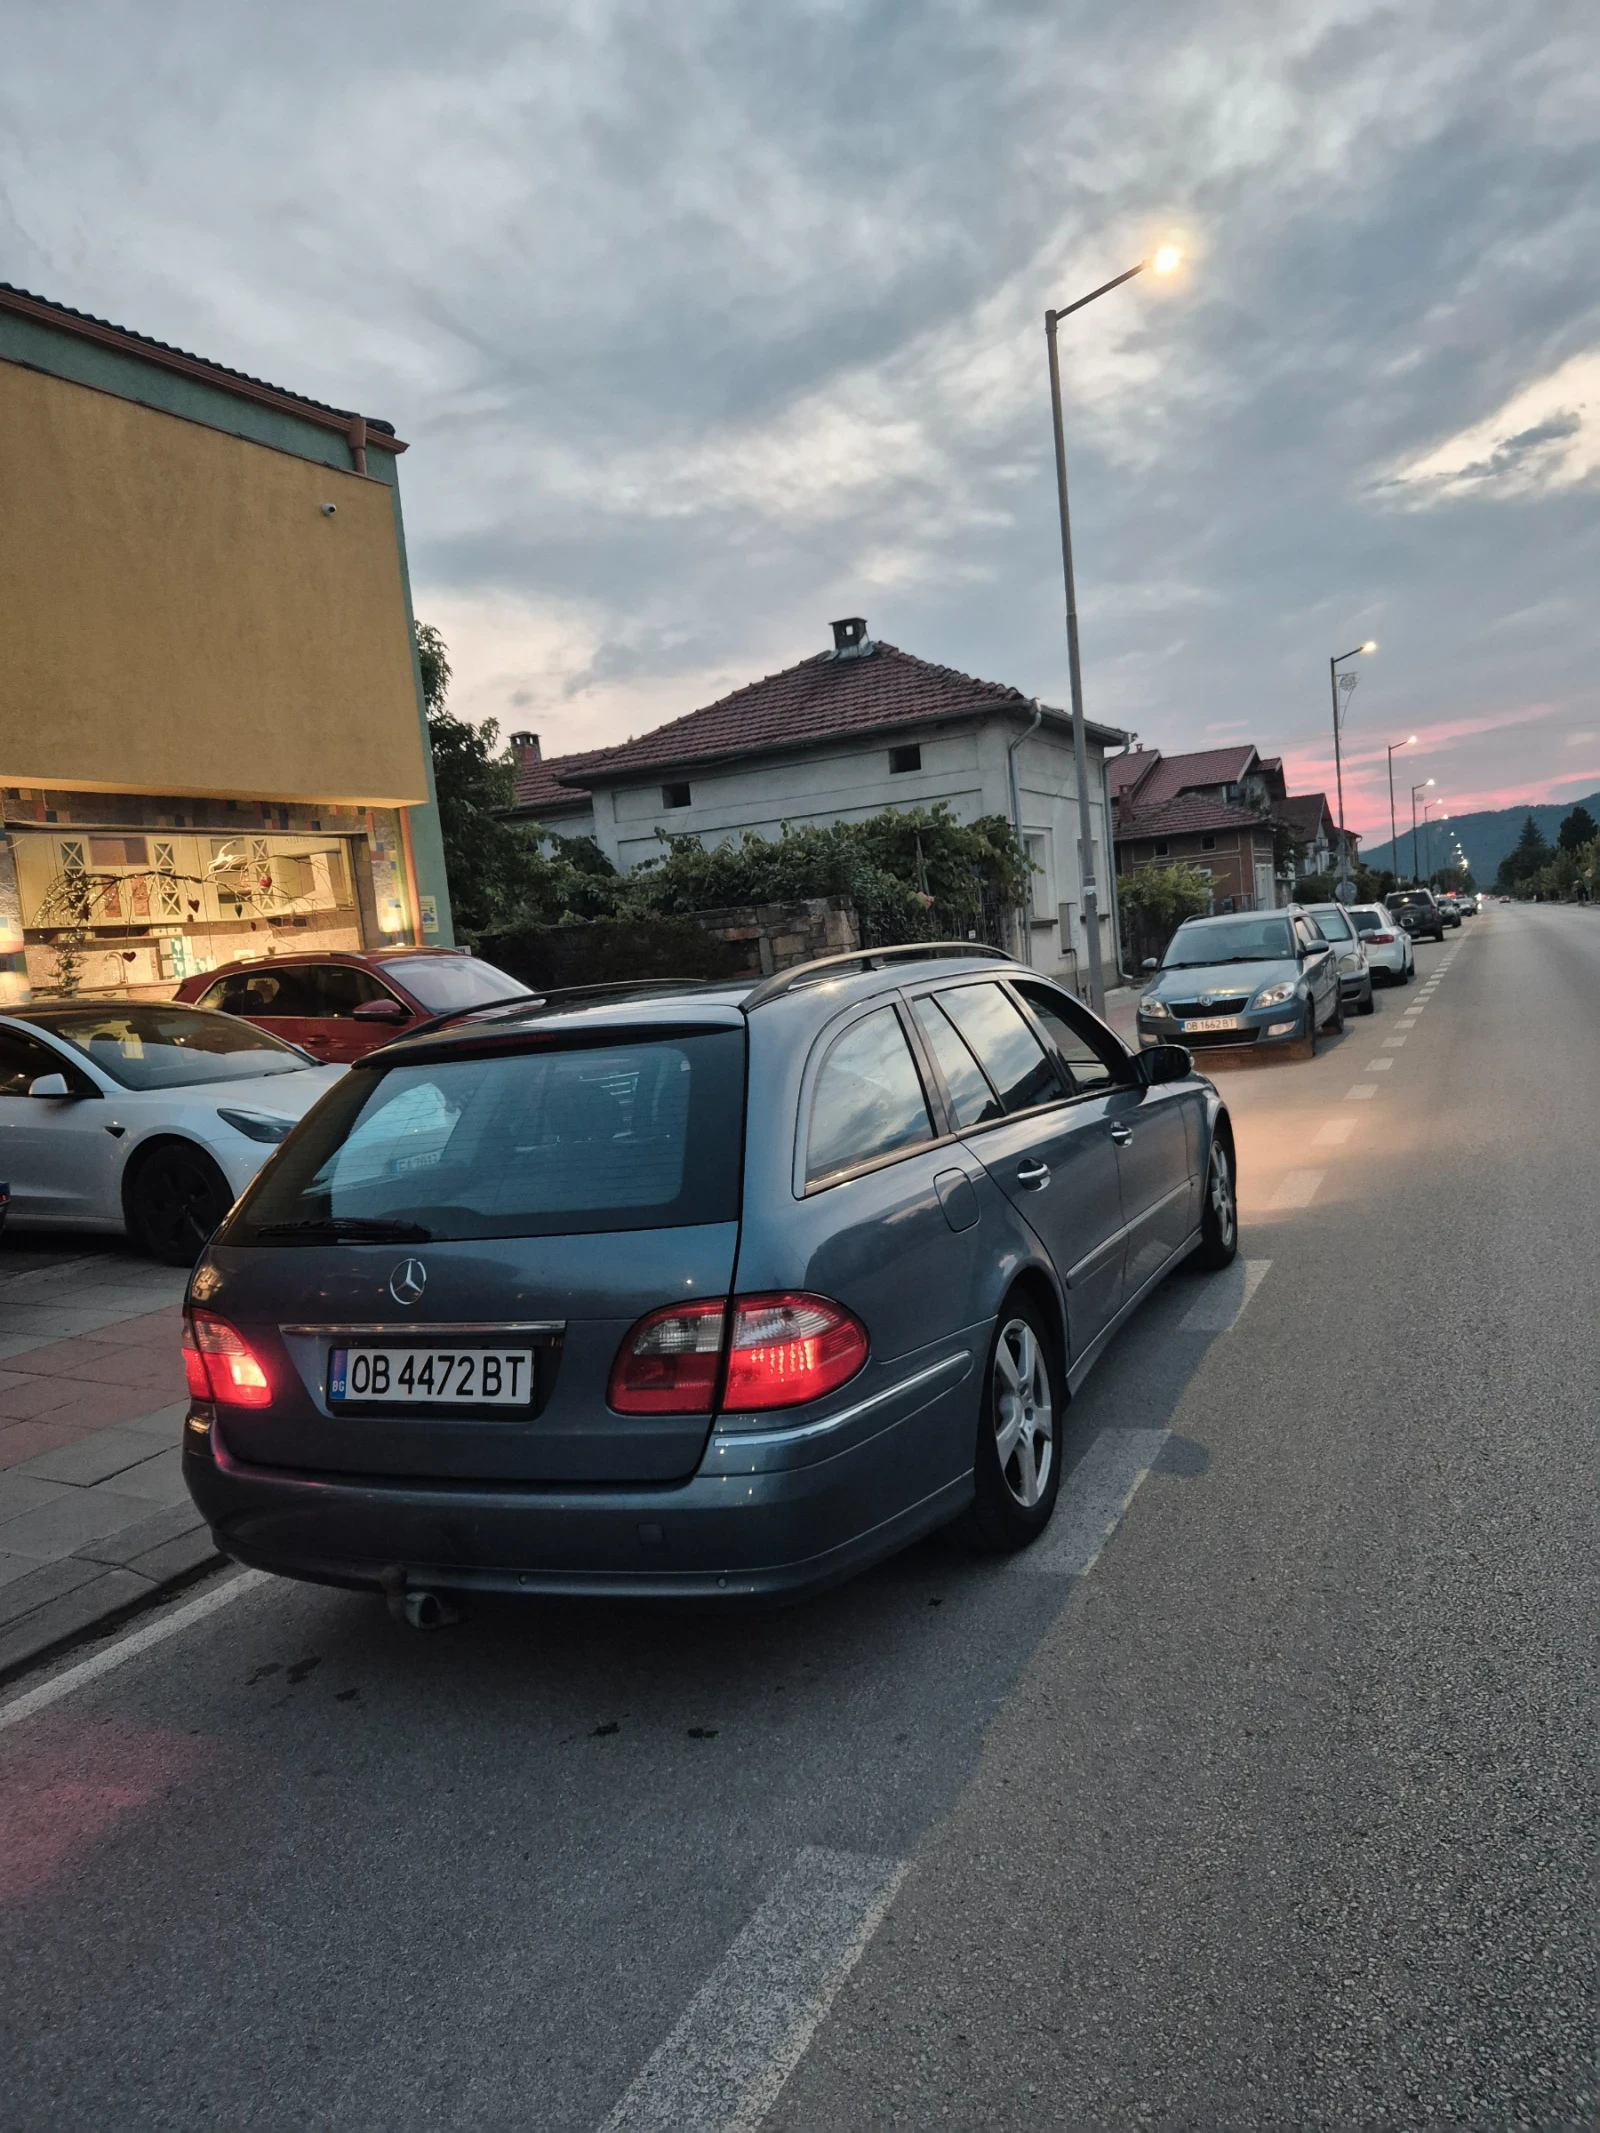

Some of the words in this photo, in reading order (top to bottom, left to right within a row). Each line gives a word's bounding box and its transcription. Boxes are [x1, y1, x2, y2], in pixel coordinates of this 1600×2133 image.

[1223, 1019, 1234, 1028] BT
[352, 1355, 390, 1393] OB
[398, 1355, 475, 1395] 4472
[482, 1356, 525, 1397] BT
[332, 1381, 345, 1392] BG
